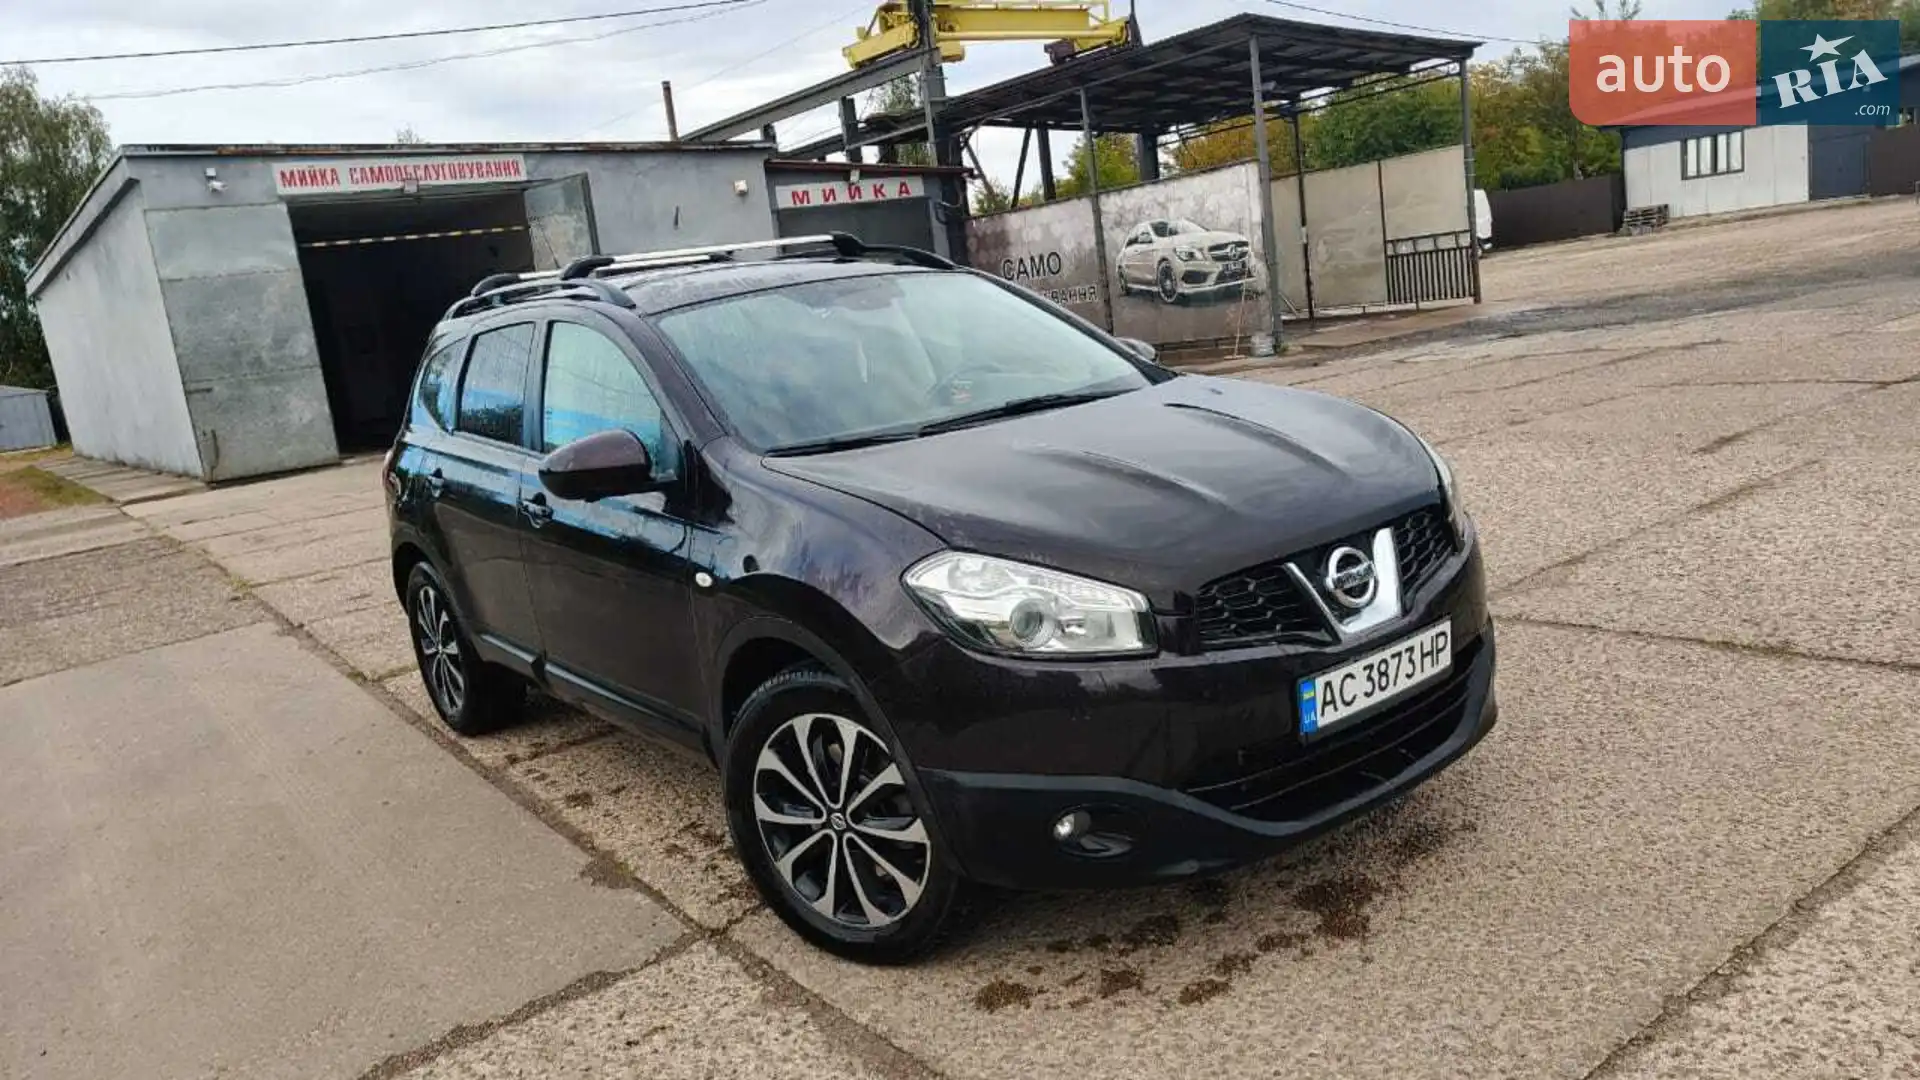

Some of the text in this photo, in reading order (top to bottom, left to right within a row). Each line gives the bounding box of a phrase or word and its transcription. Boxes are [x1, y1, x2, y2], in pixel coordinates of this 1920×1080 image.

[280, 165, 341, 189] МИЙКА
[791, 181, 912, 205] МИЙКА
[1003, 252, 1062, 280] САМО
[1322, 632, 1448, 716] AC 3873 HP
